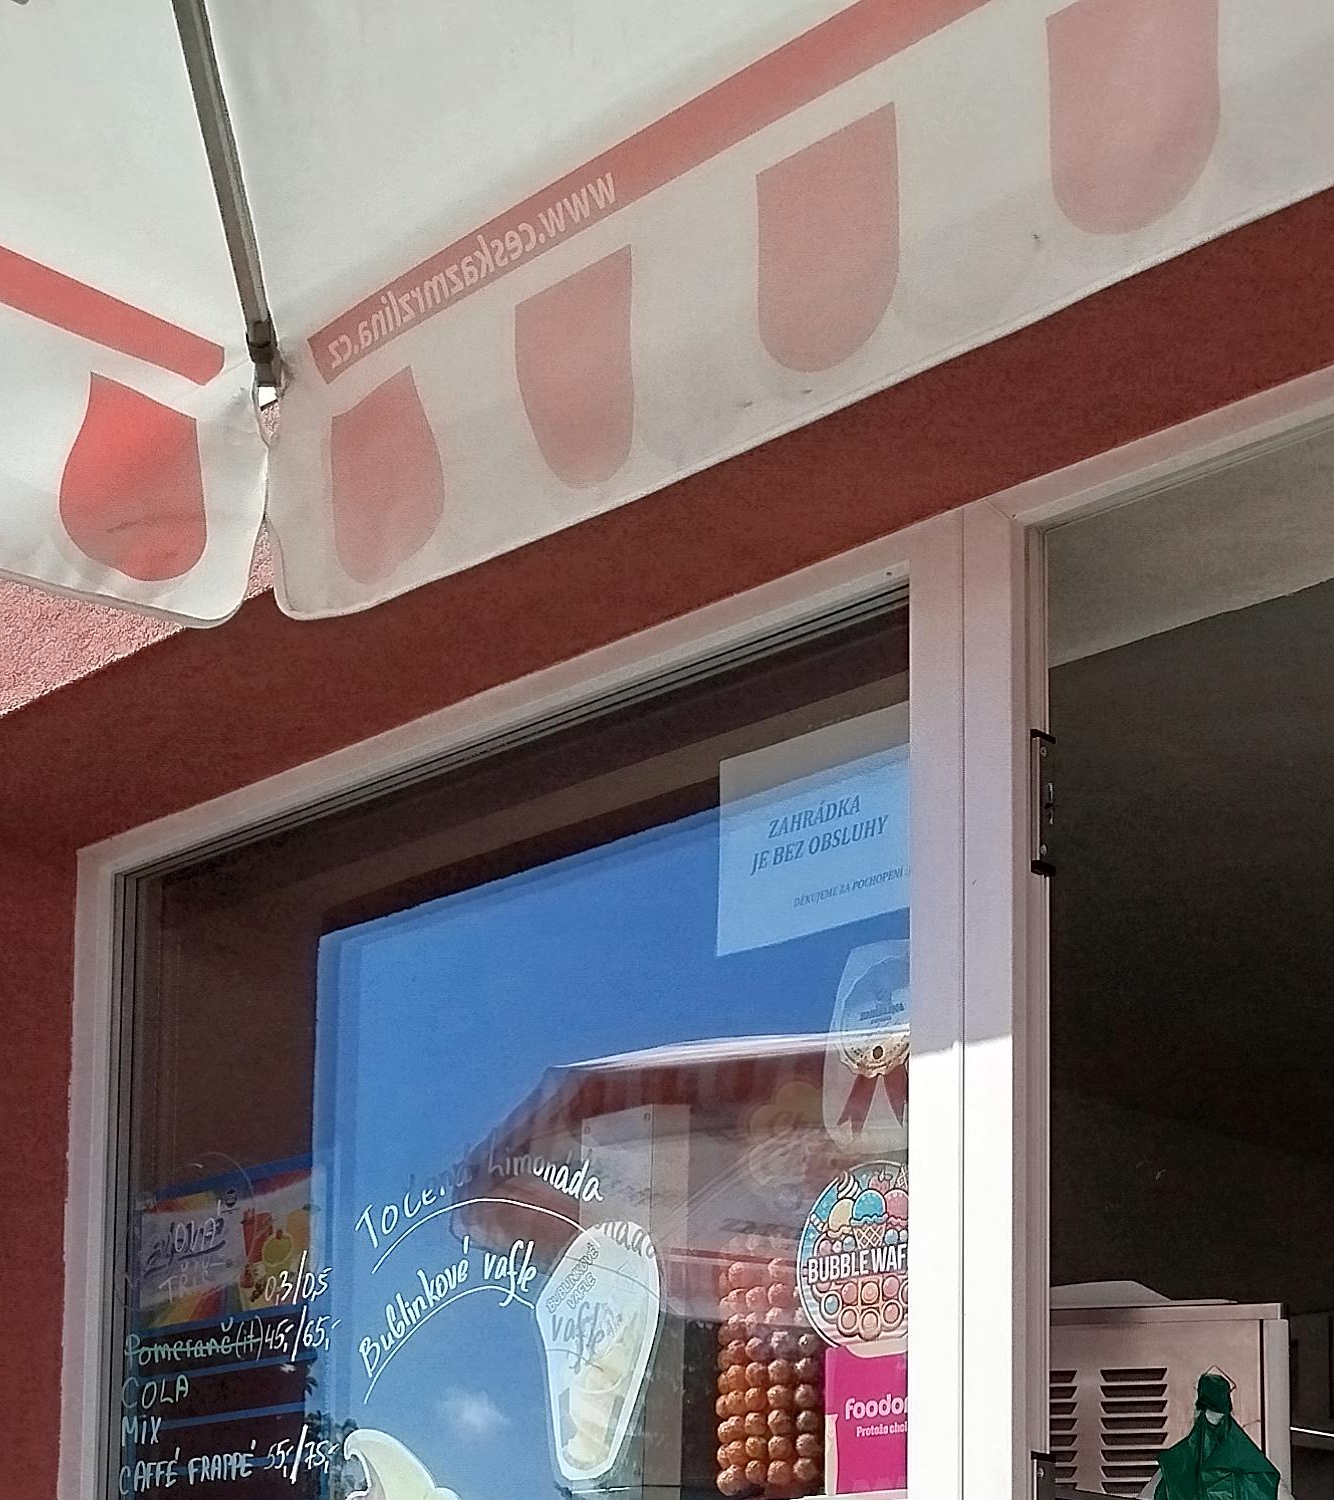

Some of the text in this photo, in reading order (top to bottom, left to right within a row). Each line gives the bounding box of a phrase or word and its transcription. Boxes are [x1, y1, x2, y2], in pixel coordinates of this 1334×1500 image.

[768, 795, 860, 838] ZAHRÁDKA
[750, 815, 889, 876] JE BEZ OBSLUHY
[808, 1249, 869, 1286] BUBBLE
[358, 1236, 538, 1378] Bublinkové vafle
[122, 1374, 190, 1410] COLA
